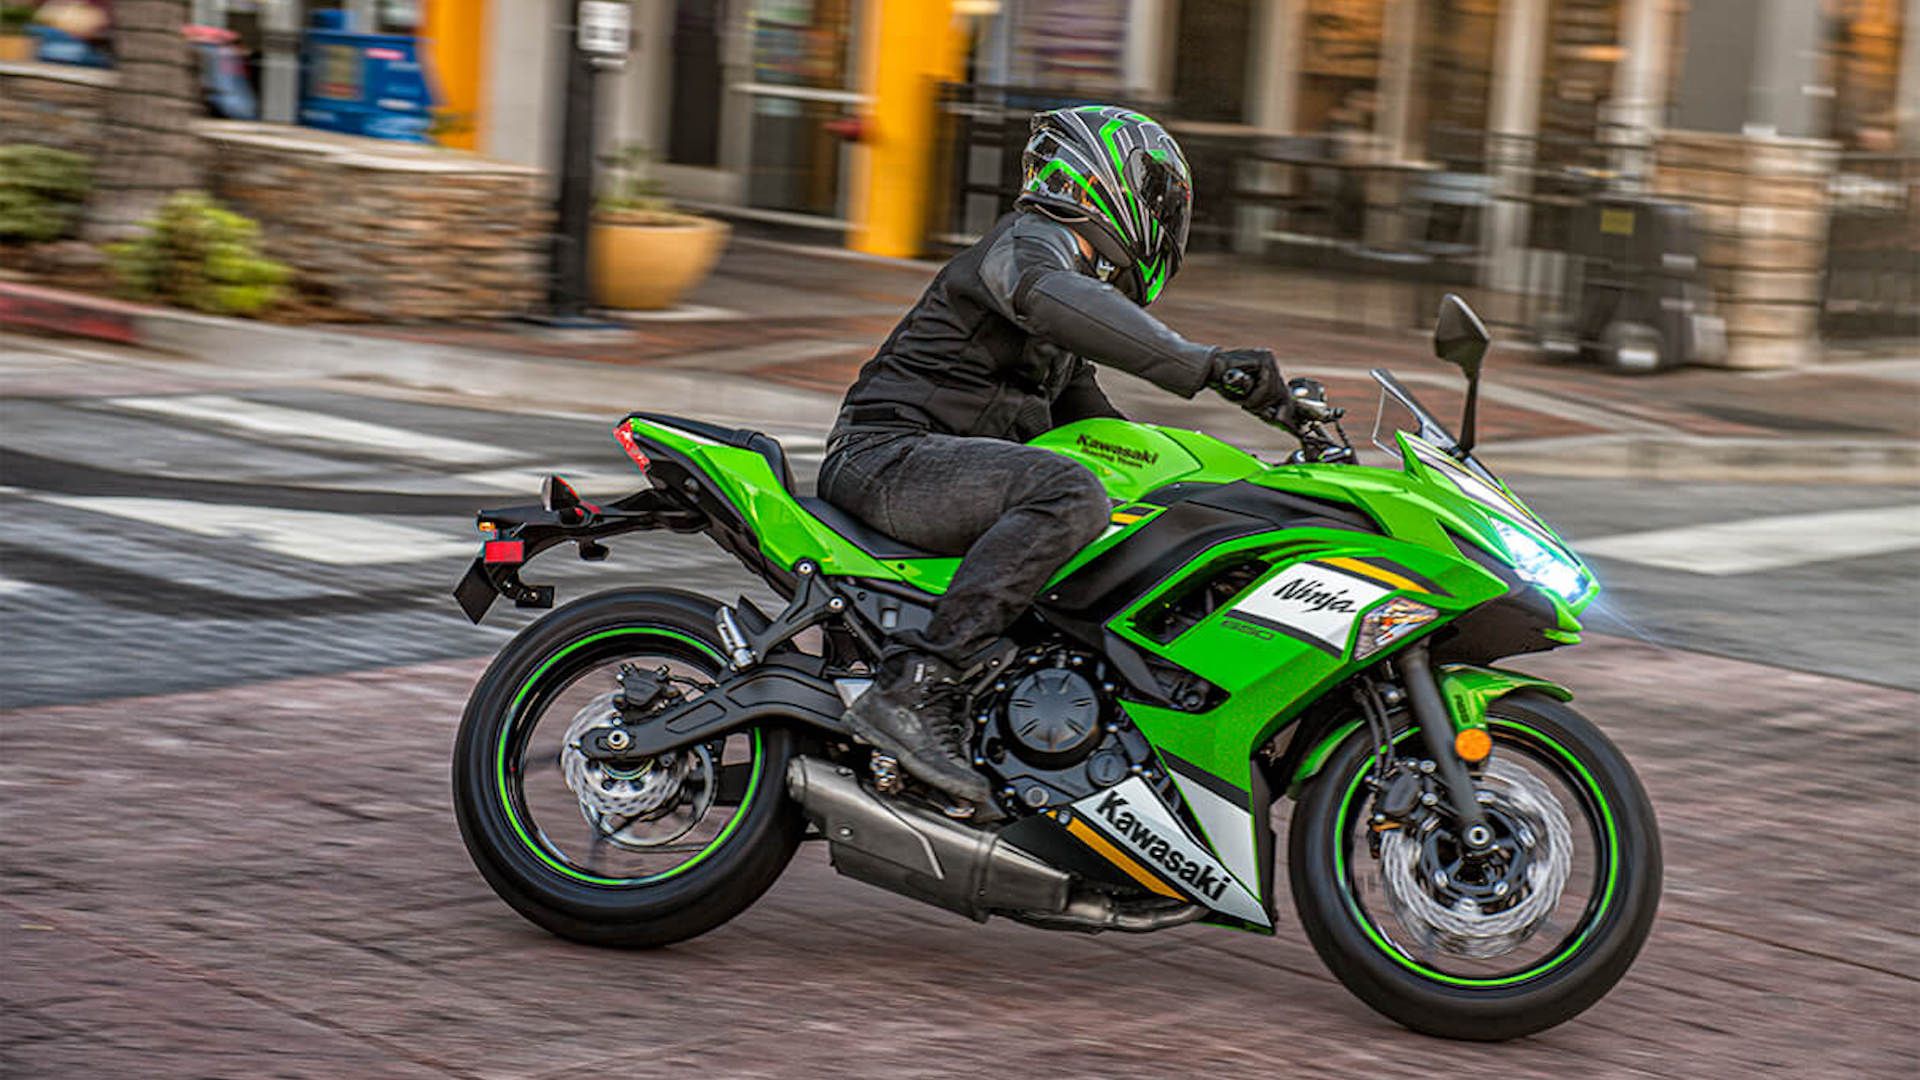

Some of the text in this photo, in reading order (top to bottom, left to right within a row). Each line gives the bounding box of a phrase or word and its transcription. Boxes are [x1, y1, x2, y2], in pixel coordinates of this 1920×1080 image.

[1076, 434, 1159, 465] Kawasaki
[1273, 578, 1357, 613] Ninja
[1096, 790, 1231, 901] Kawasaki
